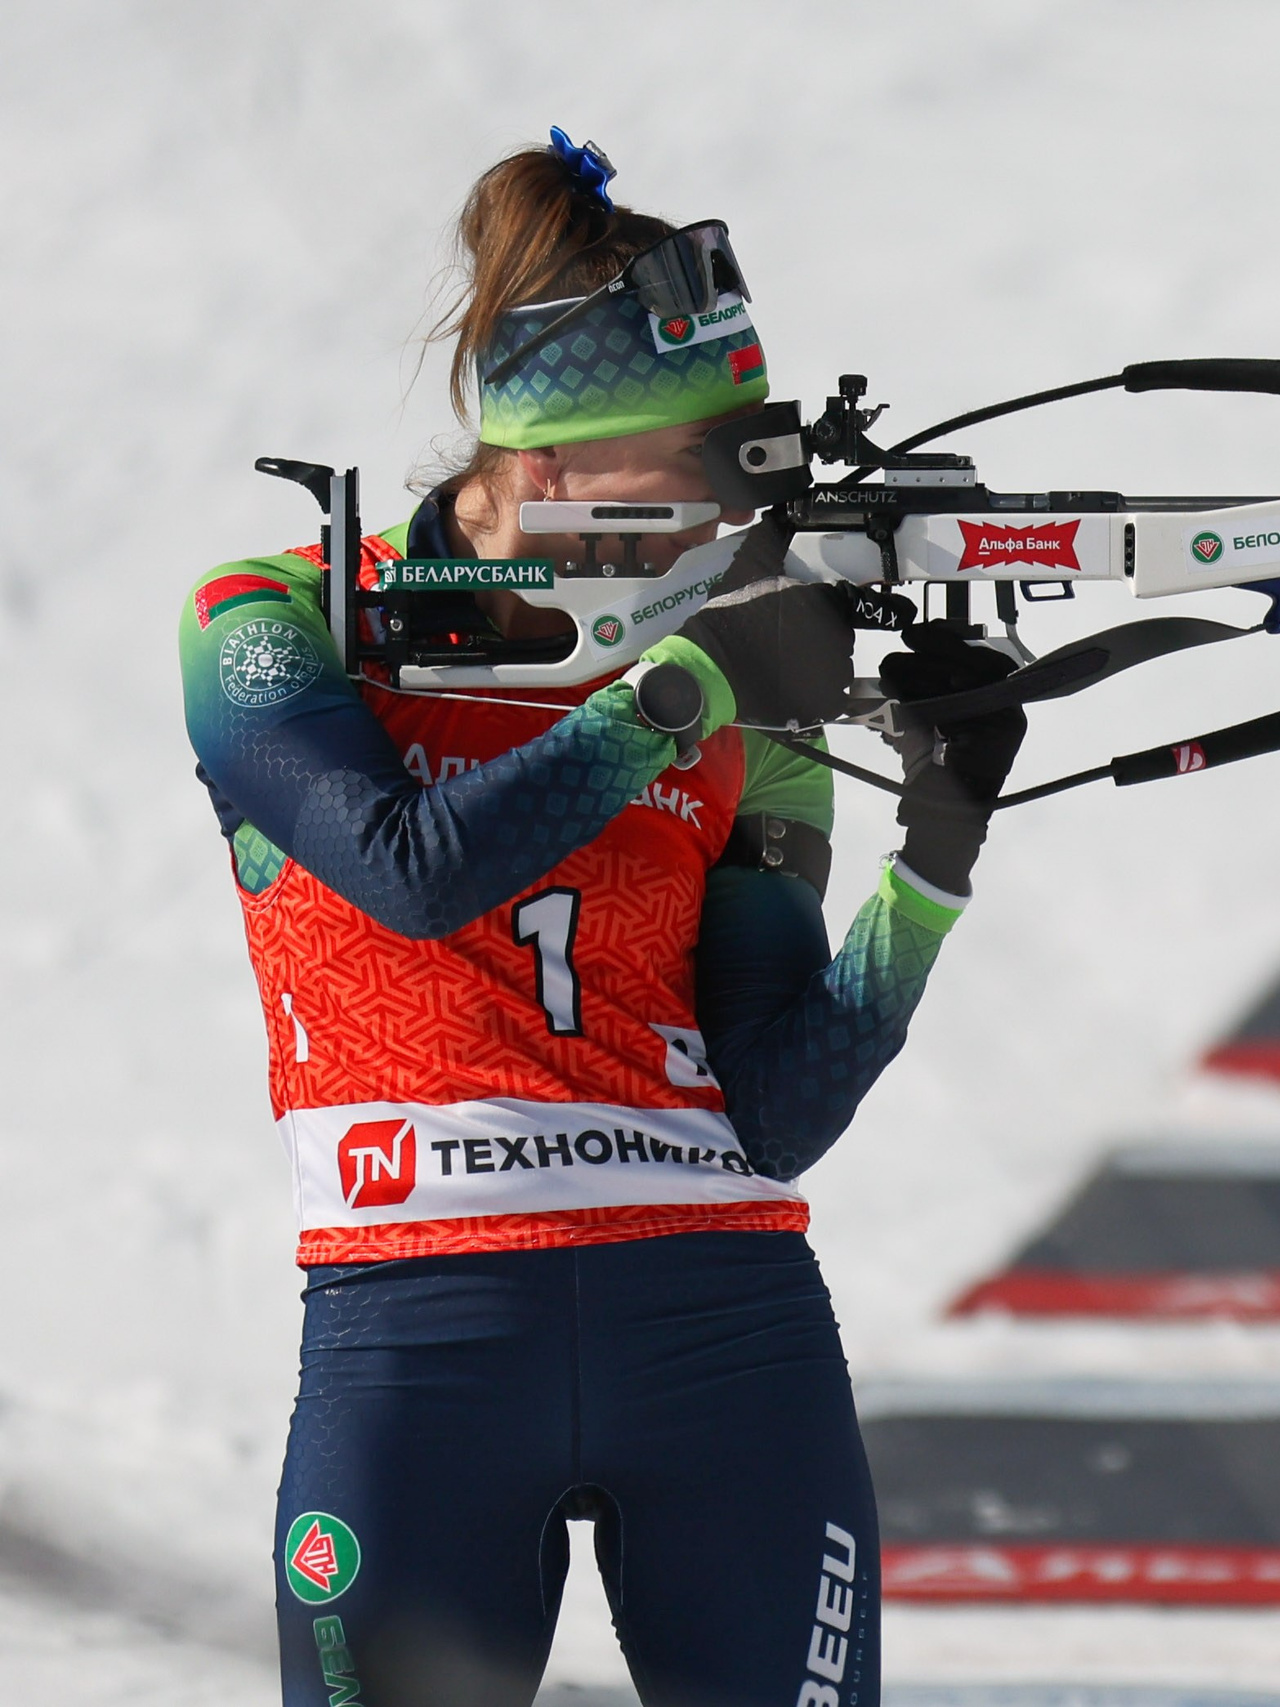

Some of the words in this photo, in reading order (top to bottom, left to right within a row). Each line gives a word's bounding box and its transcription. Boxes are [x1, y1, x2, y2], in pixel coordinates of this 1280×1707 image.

[979, 537, 1024, 555] Альфа
[1026, 537, 1061, 550] Банк
[402, 566, 547, 583] БЕЛАРУСБАНК
[222, 622, 298, 666] BIATHLON
[225, 674, 287, 704] Federation
[511, 885, 585, 1038] 1
